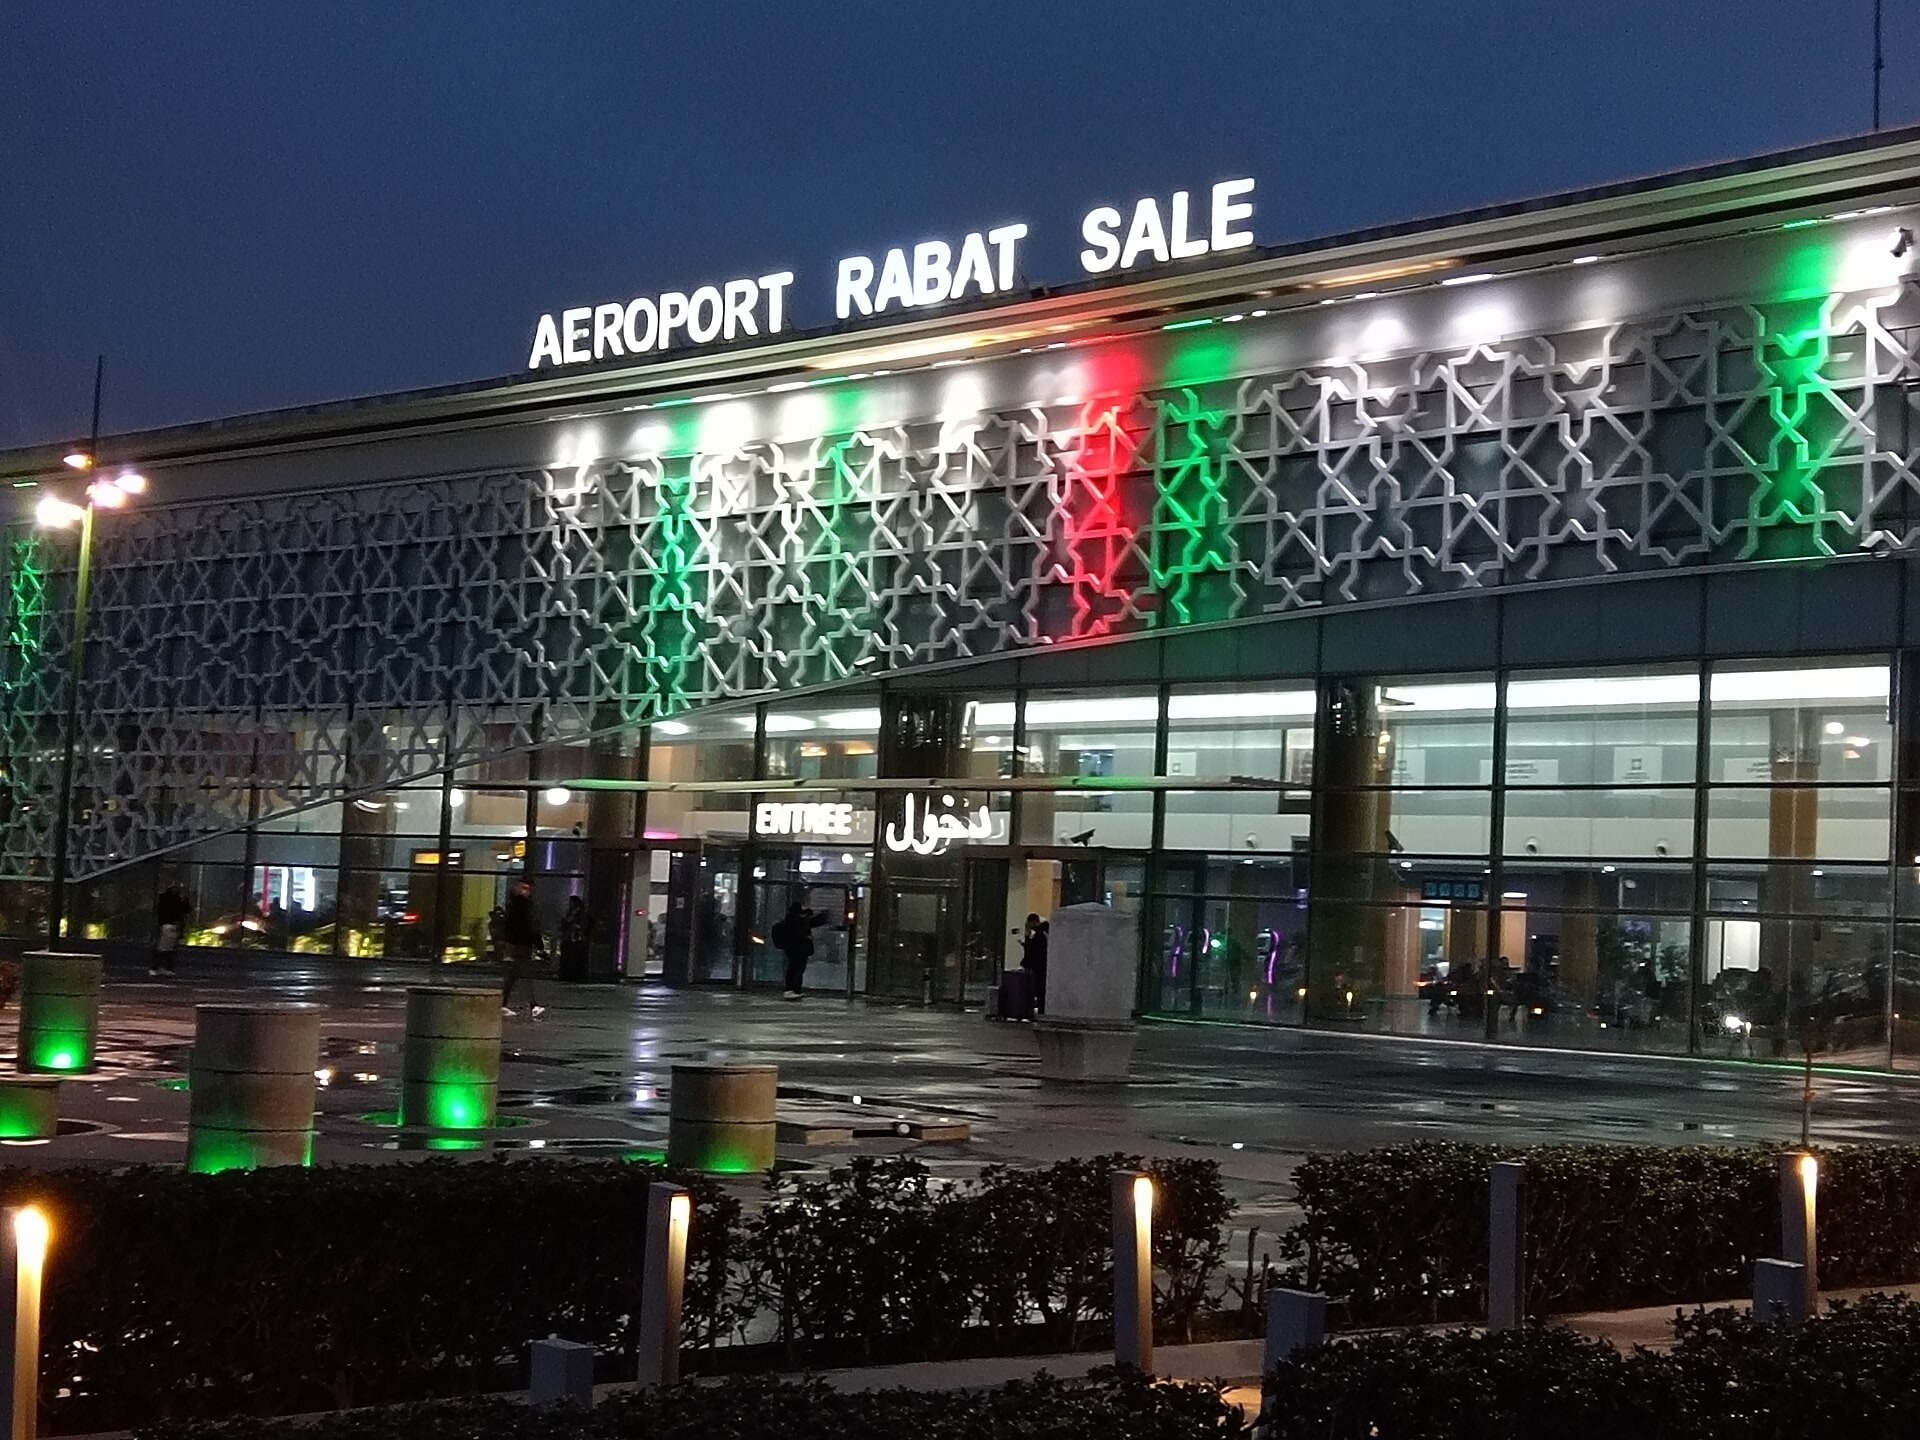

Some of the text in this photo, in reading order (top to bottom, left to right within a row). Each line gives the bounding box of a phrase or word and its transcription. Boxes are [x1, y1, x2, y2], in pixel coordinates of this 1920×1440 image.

[528, 178, 1255, 369] AEROPORT RABAT SALE
[755, 802, 853, 836] ENTREE
[885, 792, 993, 855] دخول
